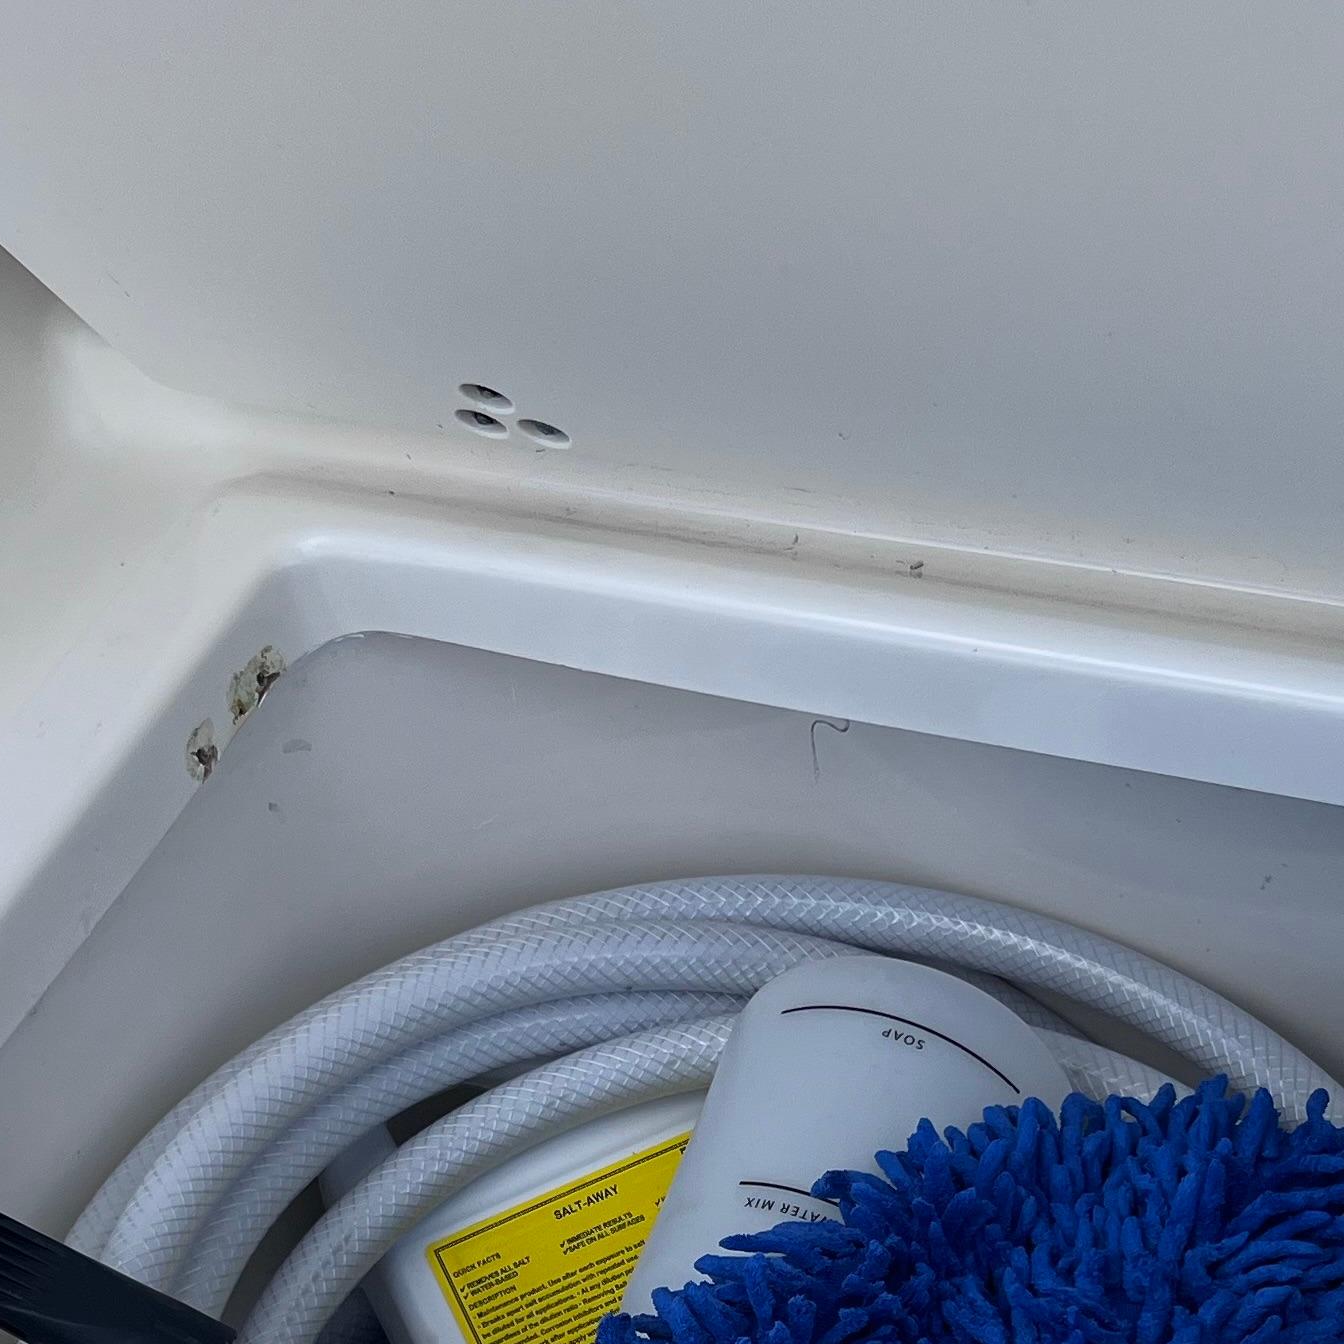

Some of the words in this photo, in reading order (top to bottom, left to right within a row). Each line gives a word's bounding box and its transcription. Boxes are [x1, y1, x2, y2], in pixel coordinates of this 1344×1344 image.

[882, 1028, 925, 1050] SOAP
[554, 1184, 617, 1219] SALT-AWAY
[744, 1197, 775, 1211] MIX
[567, 1225, 603, 1244] IMMEDIATE
[603, 1212, 633, 1229] RESULTS
[568, 1241, 586, 1252] SAFE
[586, 1236, 597, 1245] ON
[597, 1231, 610, 1240] ALL
[610, 1215, 645, 1234] SURFACES
[453, 1264, 477, 1278] QUICK
[477, 1253, 501, 1267] FACTS
[467, 1271, 499, 1289] REMOVES
[500, 1265, 513, 1275] ALL
[513, 1256, 530, 1268] SALT
[470, 1271, 518, 1296] WATER-BASED
[477, 1297, 519, 1319] Maintenance
[547, 1278, 561, 1287] Use
[562, 1270, 577, 1280] after
[579, 1263, 595, 1272] each
[596, 1250, 625, 1265] exposure
[633, 1240, 645, 1249] salt
[538, 1280, 582, 1302] accumulation
[581, 1273, 596, 1282] with
[596, 1259, 626, 1276] repeated
[468, 1285, 516, 1311] DESCRIPTION
[582, 1288, 615, 1305] Removing
[540, 1318, 573, 1336] Corrosion
